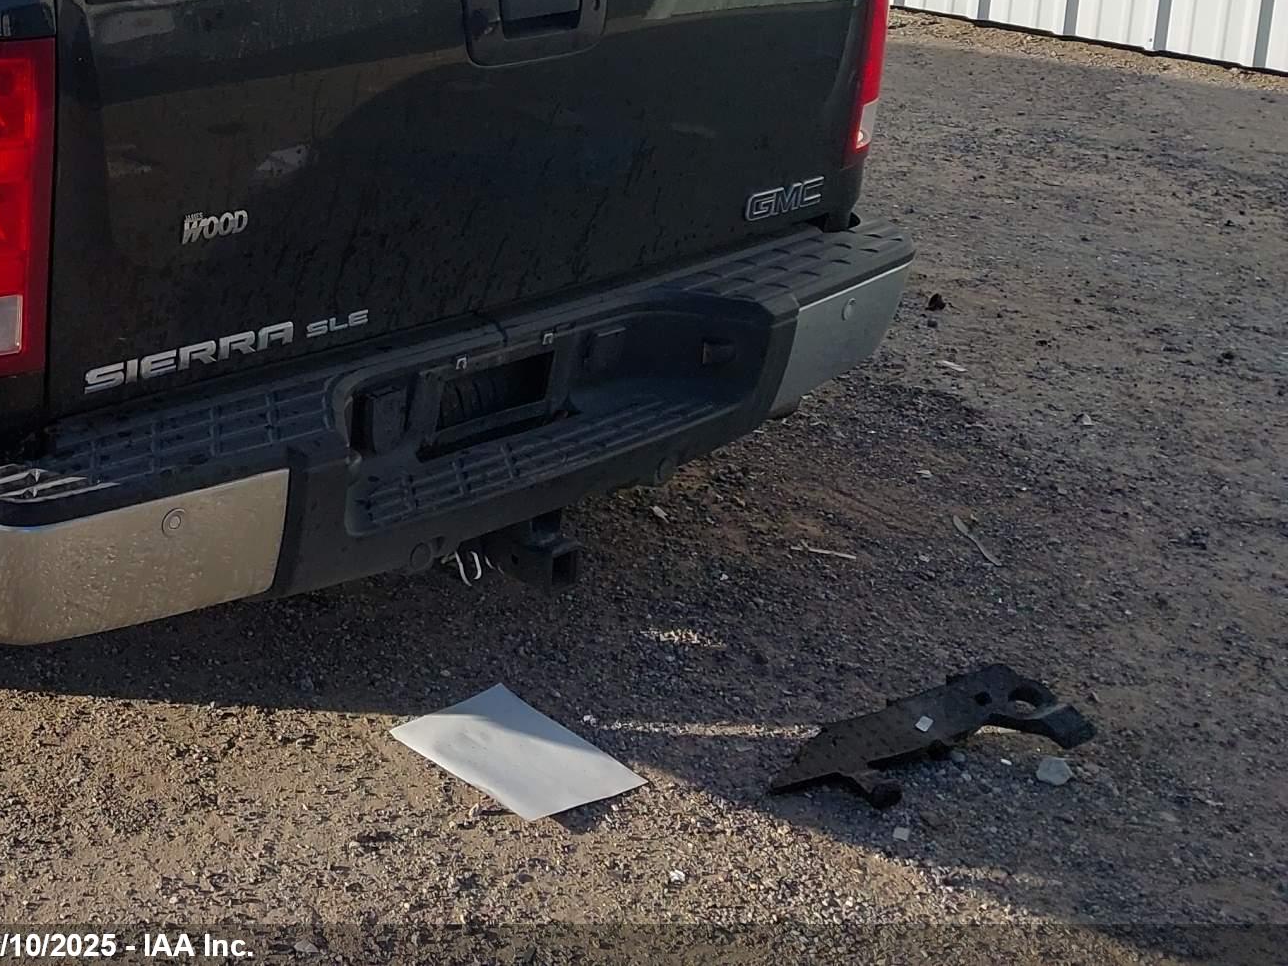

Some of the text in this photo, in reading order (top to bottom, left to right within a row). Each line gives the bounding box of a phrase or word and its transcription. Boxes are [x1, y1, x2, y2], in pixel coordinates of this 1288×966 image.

[745, 176, 825, 222] GMC
[182, 210, 248, 245] WOOD
[84, 309, 369, 395] SIERRA SLE
